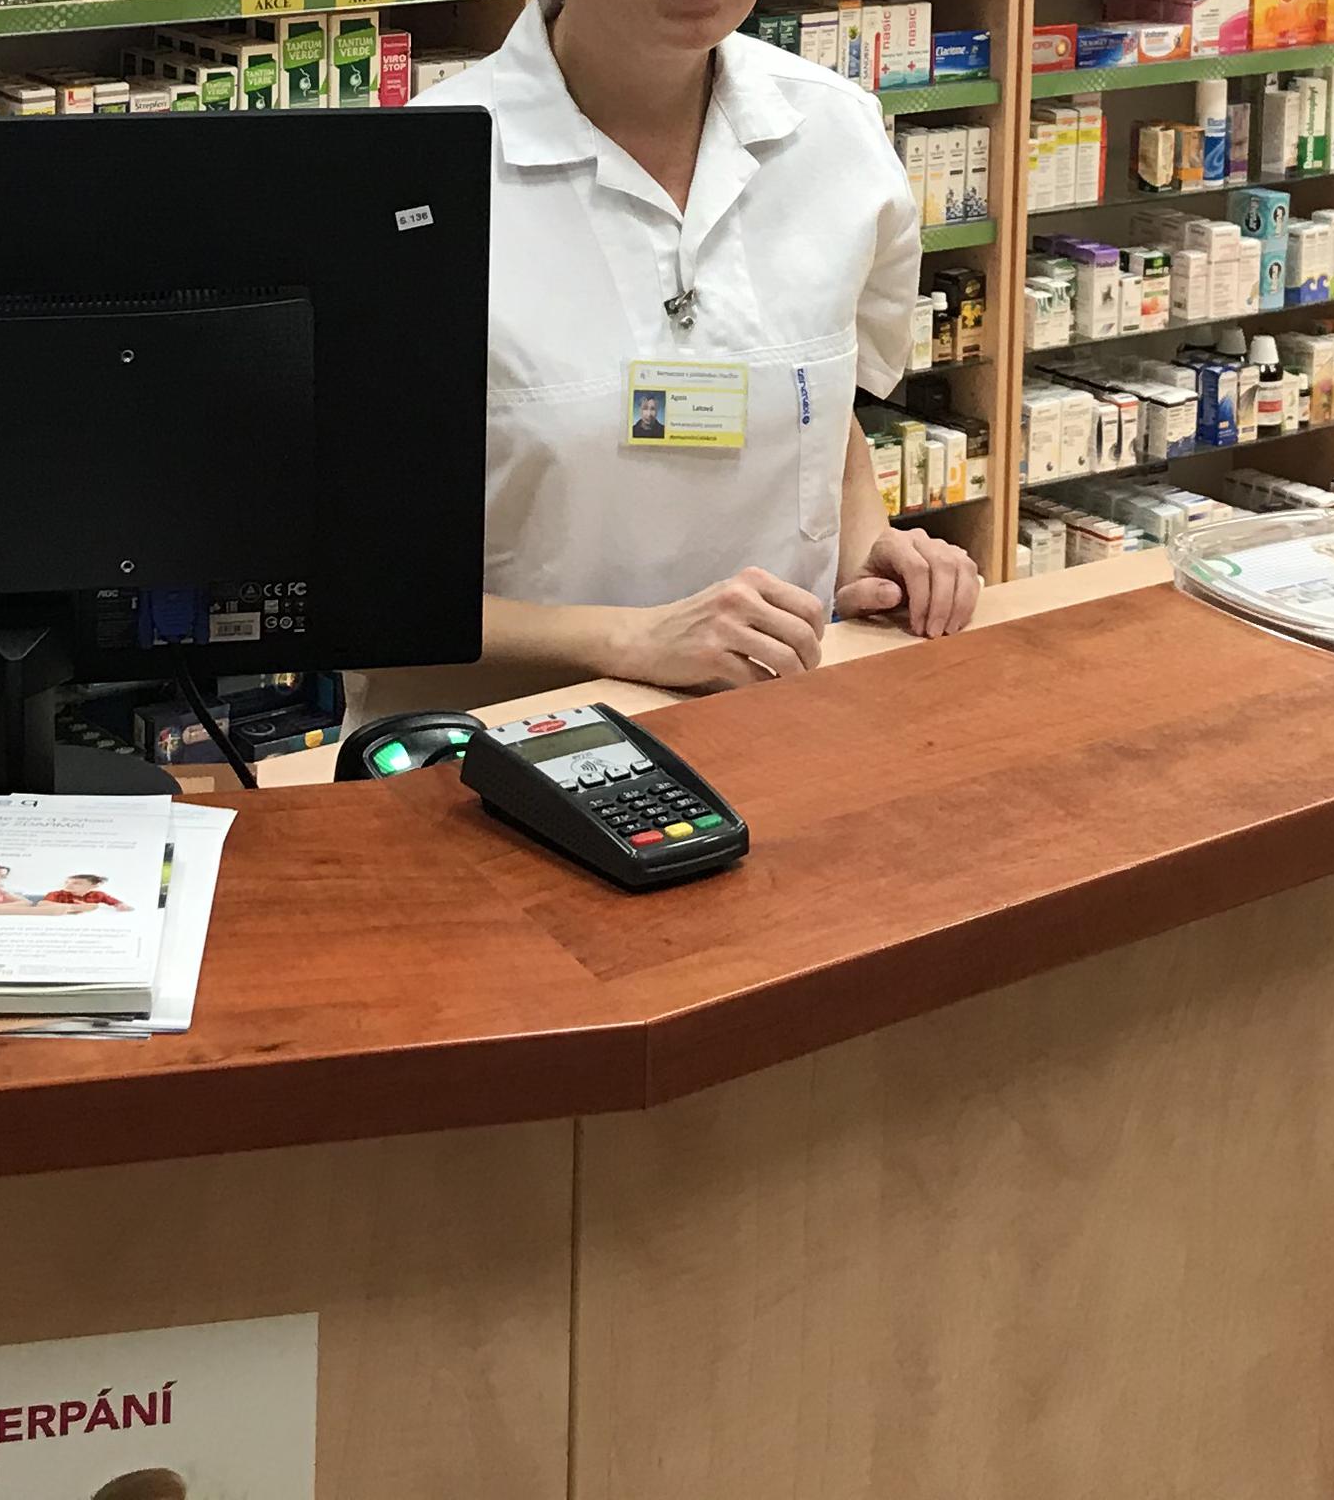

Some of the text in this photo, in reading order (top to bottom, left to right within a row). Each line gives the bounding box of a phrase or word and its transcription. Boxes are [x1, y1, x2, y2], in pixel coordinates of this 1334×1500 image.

[882, 10, 892, 50] nasic
[907, 8, 917, 47] nasic
[286, 39, 322, 53] TANTUM
[289, 49, 320, 61] VERDE
[383, 55, 406, 65] VIRO
[383, 63, 406, 72] STOP
